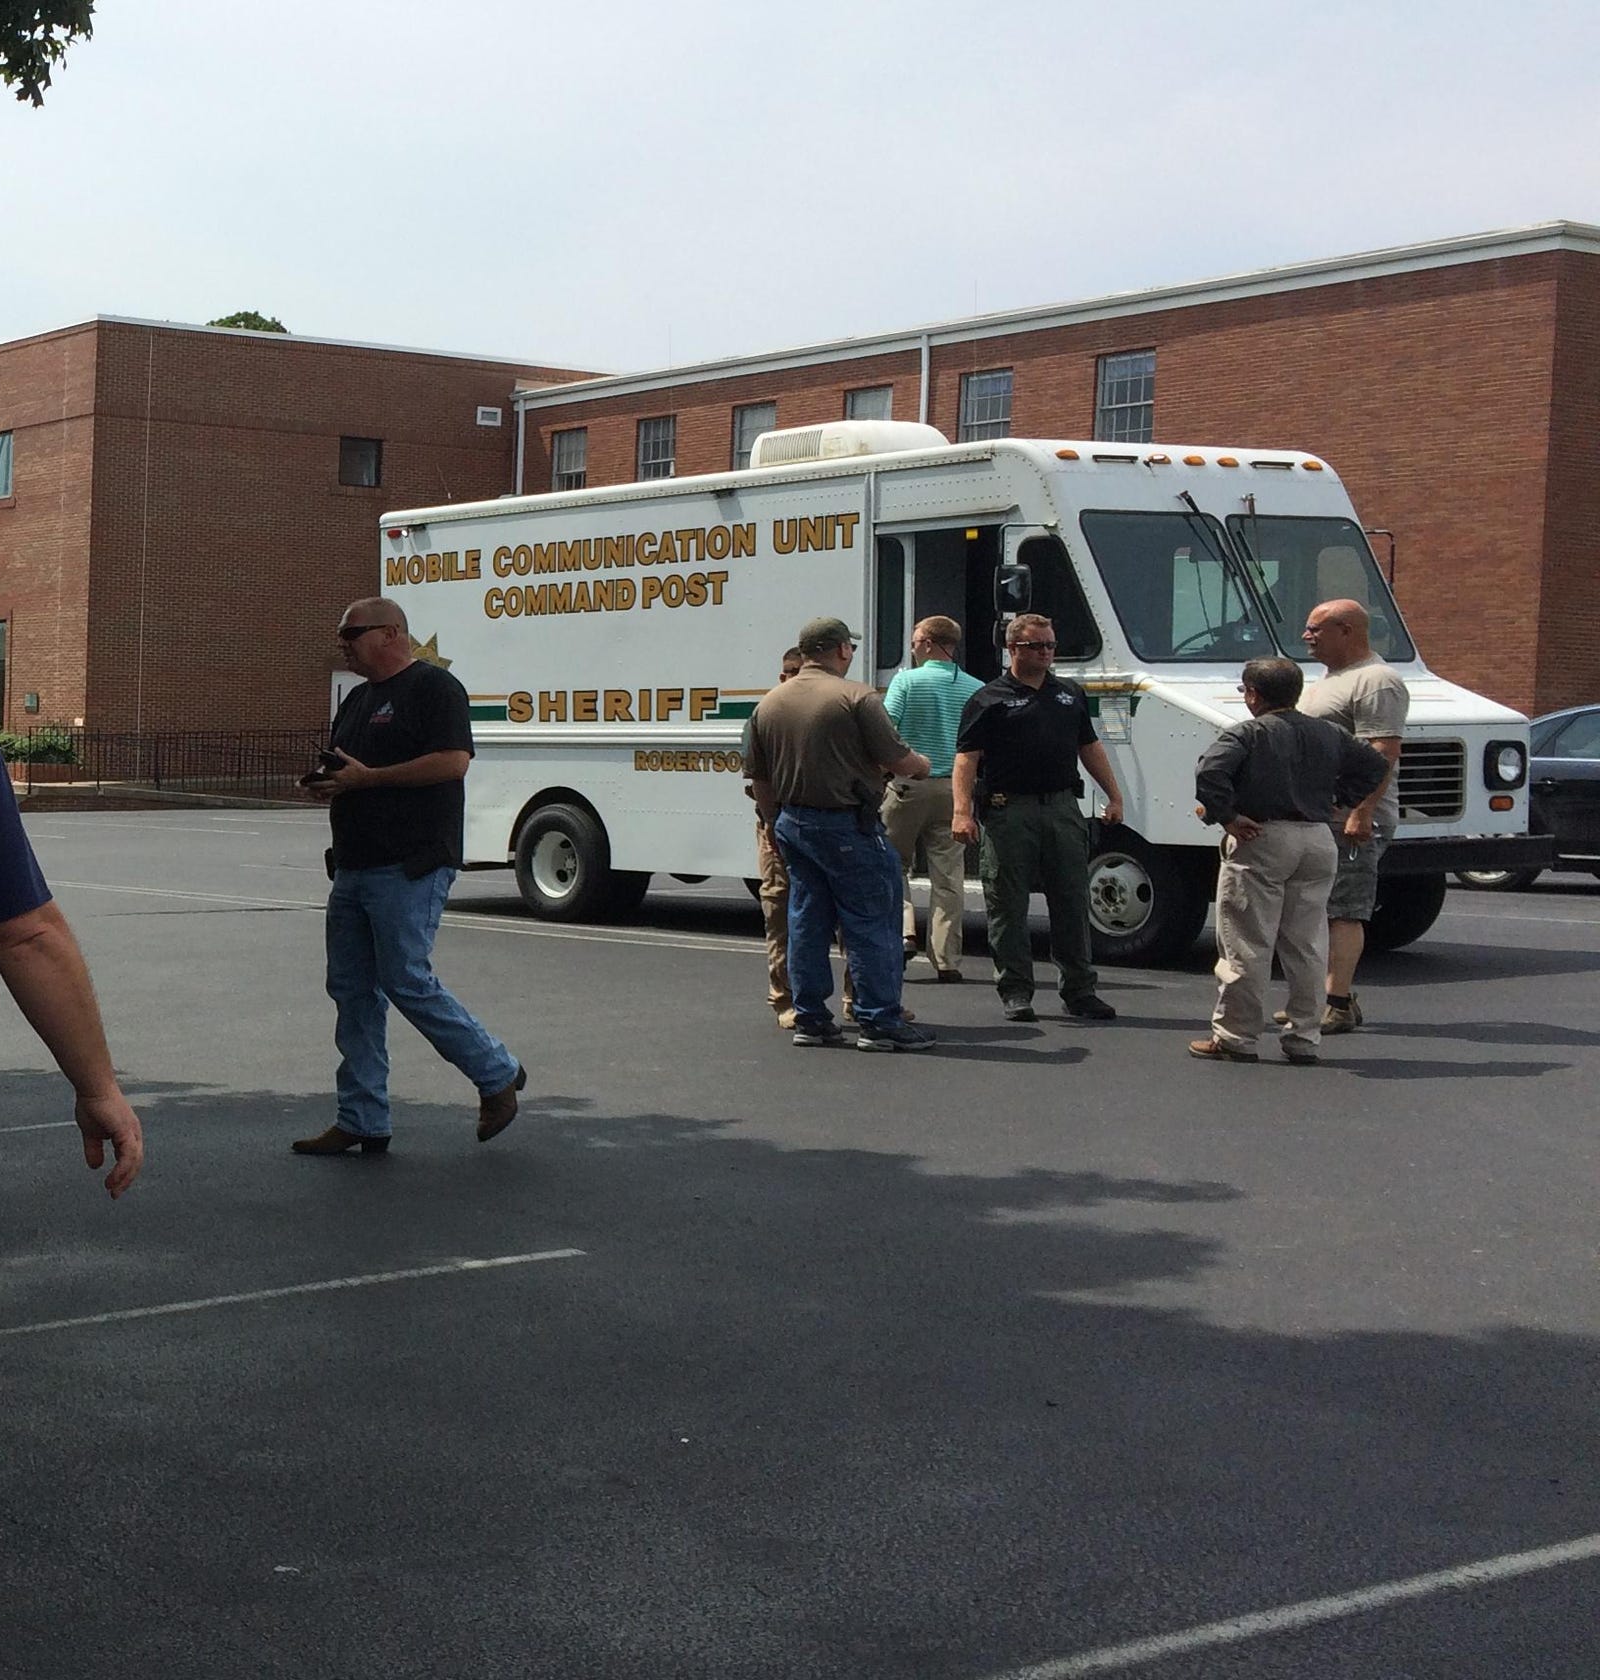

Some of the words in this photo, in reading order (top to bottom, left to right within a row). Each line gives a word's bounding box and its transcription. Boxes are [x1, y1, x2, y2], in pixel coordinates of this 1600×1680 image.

[386, 549, 481, 586] MOBILE
[493, 523, 756, 578] COMMUNICATION
[773, 512, 860, 554] UNIT
[484, 578, 636, 619] COMMAND
[642, 571, 729, 609] POST
[508, 688, 718, 723] SHERIFF
